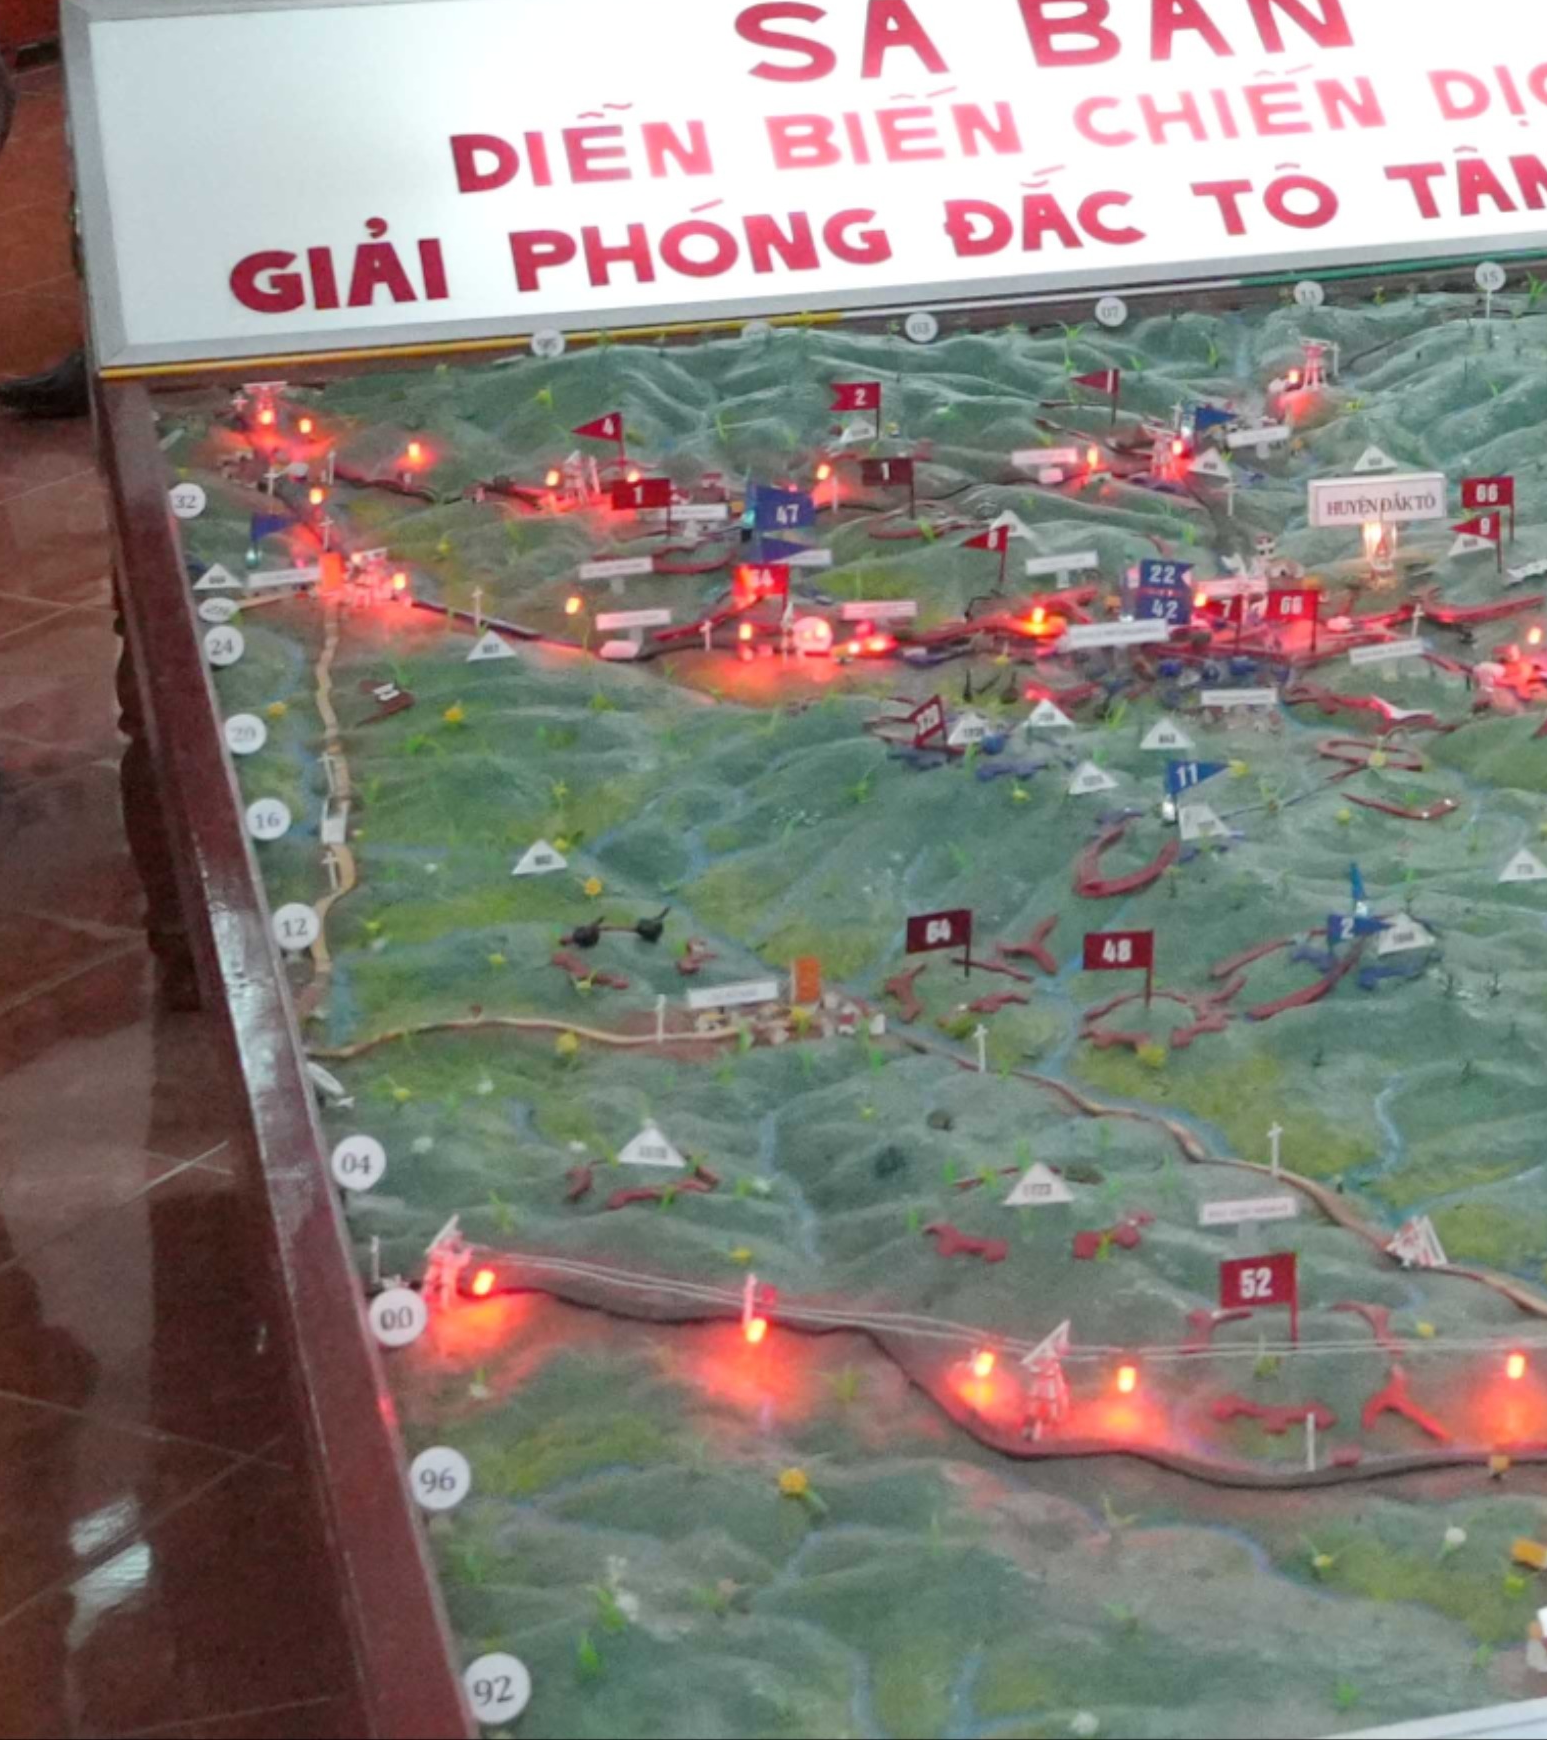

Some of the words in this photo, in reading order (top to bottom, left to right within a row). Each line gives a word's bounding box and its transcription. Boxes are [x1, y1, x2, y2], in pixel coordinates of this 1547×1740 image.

[448, 101, 714, 195] DIỄN
[764, 85, 1024, 173] BIẾN
[1070, 63, 1388, 149] CHIẾN
[228, 216, 452, 316] GIẢI
[507, 198, 894, 294] PHÓNG
[940, 164, 1149, 259] ĐẮC
[1189, 161, 1342, 238] TÔ
[854, 388, 867, 408] 2
[602, 416, 614, 436] 4
[173, 493, 197, 509] 32
[775, 503, 800, 525] 47
[1149, 564, 1177, 586] 22
[1150, 598, 1179, 621] 42
[209, 638, 233, 656] 24
[1175, 762, 1199, 789] 11
[254, 811, 281, 831] 16
[281, 917, 308, 939] 12
[1101, 938, 1132, 964] 48
[340, 1152, 371, 1176] 04
[1239, 1267, 1273, 1300] 52
[379, 1305, 414, 1332] 00
[419, 1467, 457, 1494] 96
[472, 1675, 515, 1708] 92
